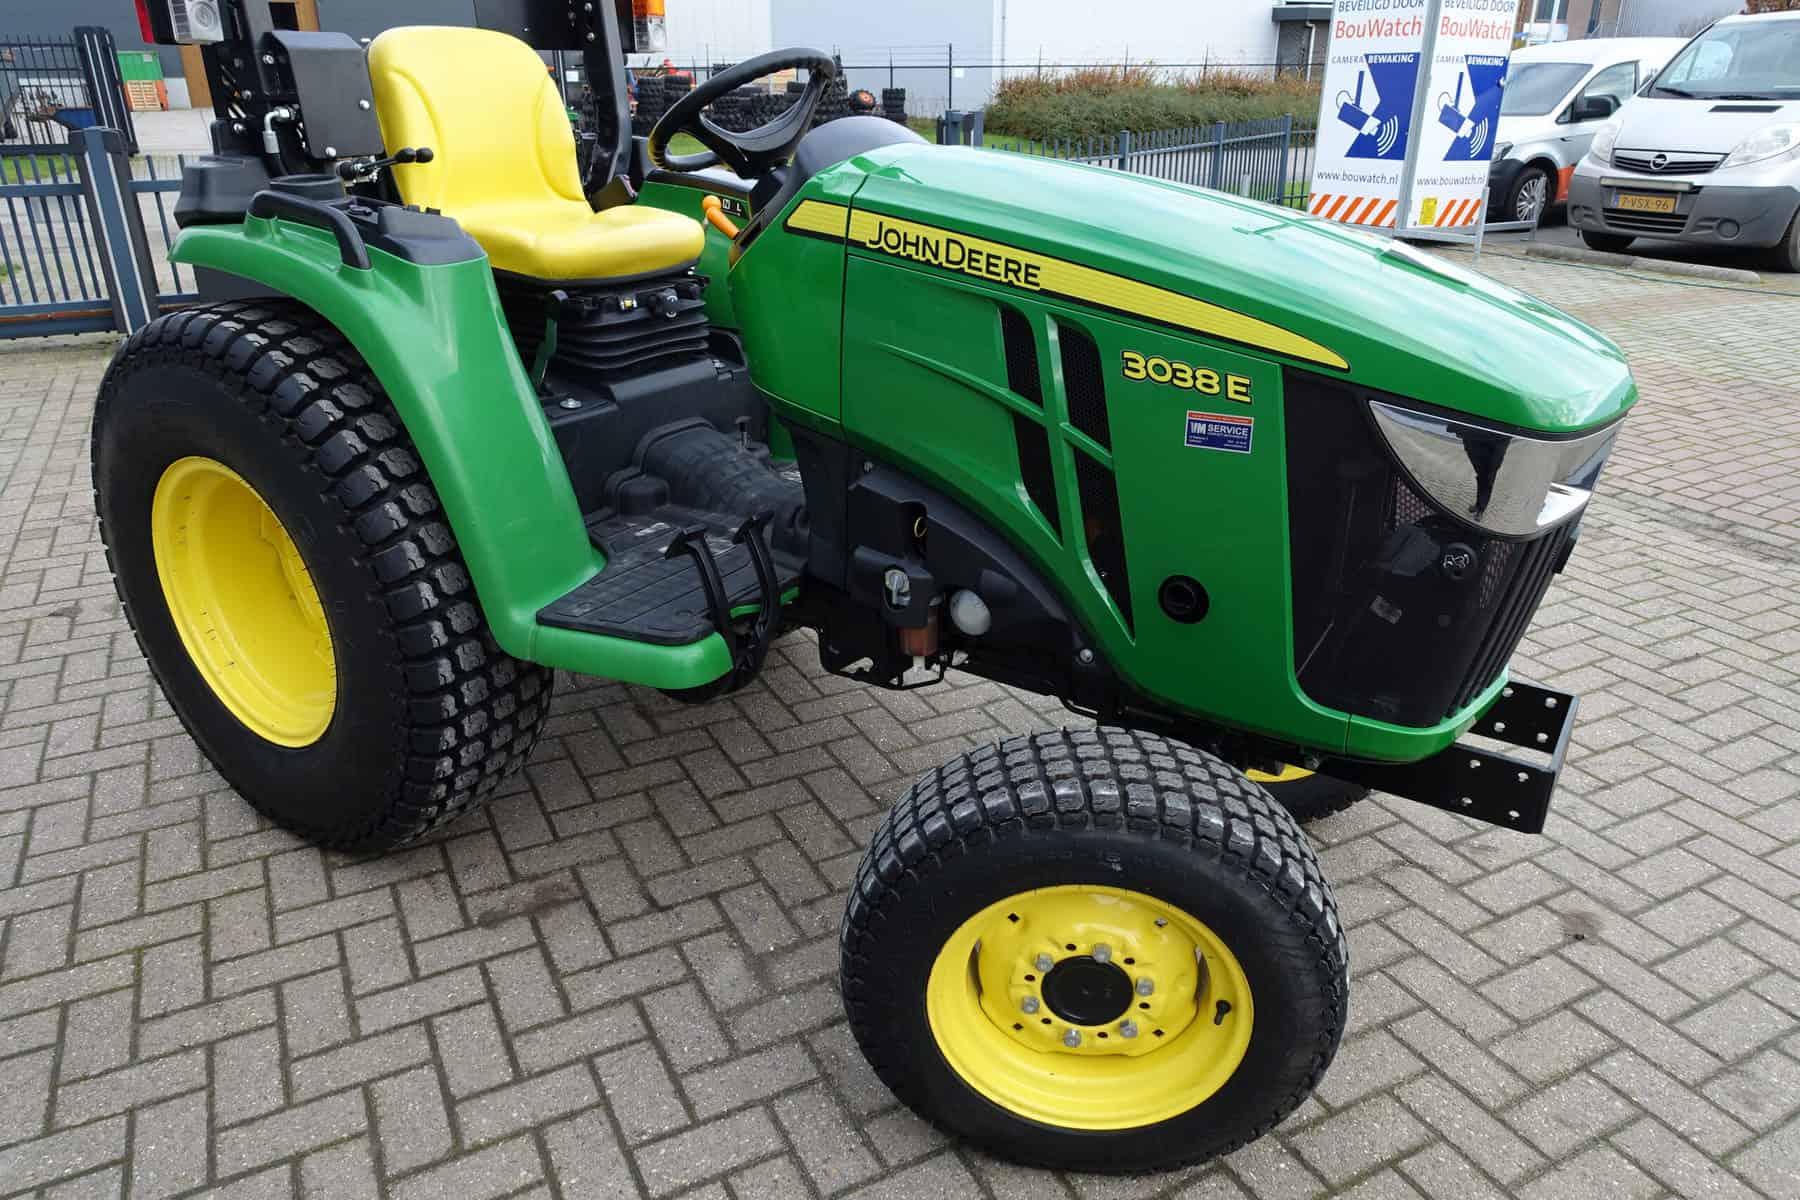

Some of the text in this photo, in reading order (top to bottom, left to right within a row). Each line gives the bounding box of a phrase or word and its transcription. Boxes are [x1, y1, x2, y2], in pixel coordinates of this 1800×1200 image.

[1338, 0, 1425, 12] BEVEILIGD DOOR
[1444, 0, 1516, 13] BEVEILIGD DOOR
[1335, 16, 1421, 39] BouWatch
[1440, 16, 1511, 40] BouWatch
[1331, 54, 1414, 65] CAMERA BEWAKING
[1435, 55, 1504, 66] CAMERA BEWAKING
[1317, 170, 1399, 185] www.bouwatch.nl
[1417, 174, 1486, 186] www.bouwatch.nl
[868, 221, 1041, 287] JOHN DEERE
[1207, 423, 1249, 437] SERVICE
